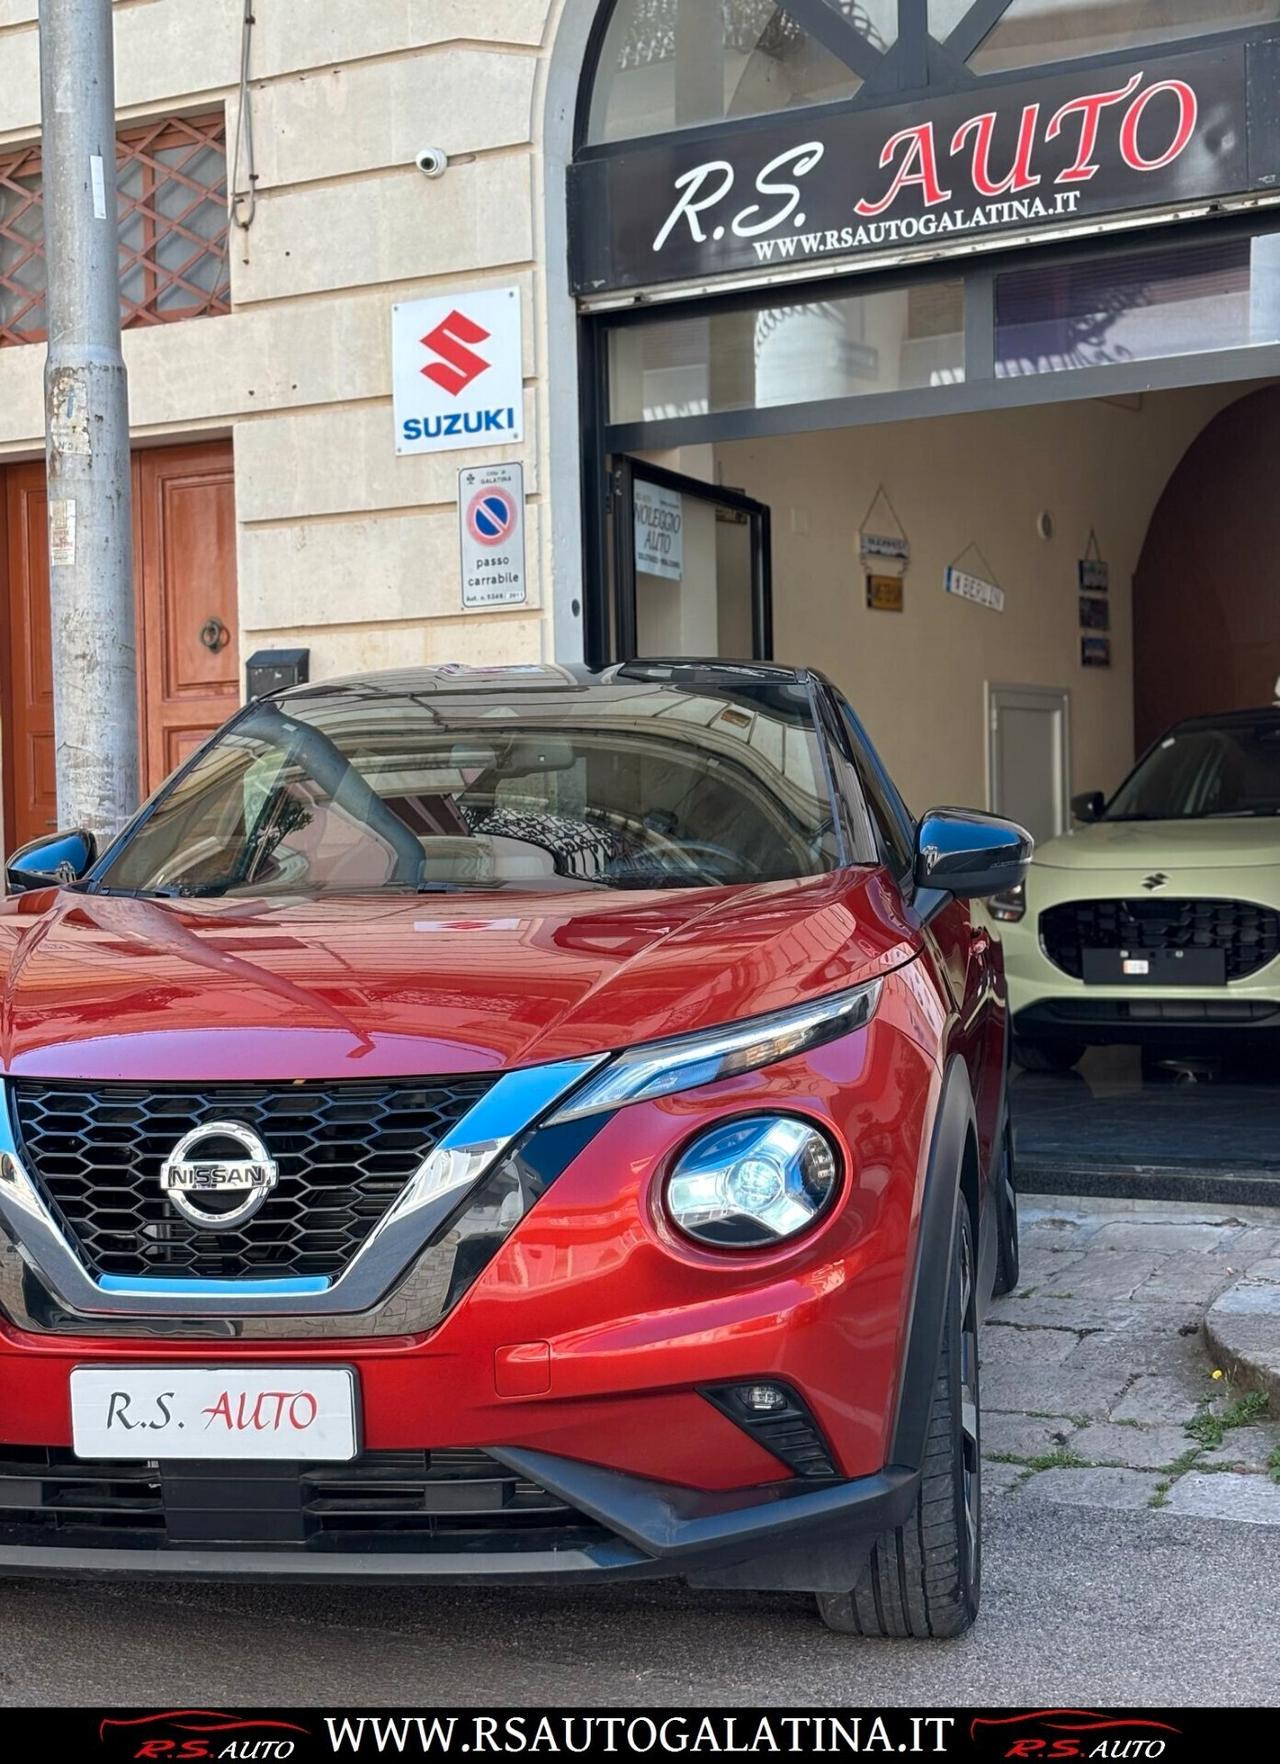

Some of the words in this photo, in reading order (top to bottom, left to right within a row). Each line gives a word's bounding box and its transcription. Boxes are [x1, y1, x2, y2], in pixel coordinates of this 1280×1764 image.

[652, 140, 824, 251] R.S.
[854, 72, 1198, 216] AUTO
[753, 190, 1080, 261] WWW.RSAUTOGALATINA.IT
[402, 407, 515, 440] SUZUKI
[476, 556, 510, 569] passo
[468, 572, 519, 587] carrabile
[170, 1166, 264, 1184] NISSAN
[106, 1391, 184, 1430] R.S.
[201, 1390, 317, 1430] AUTO
